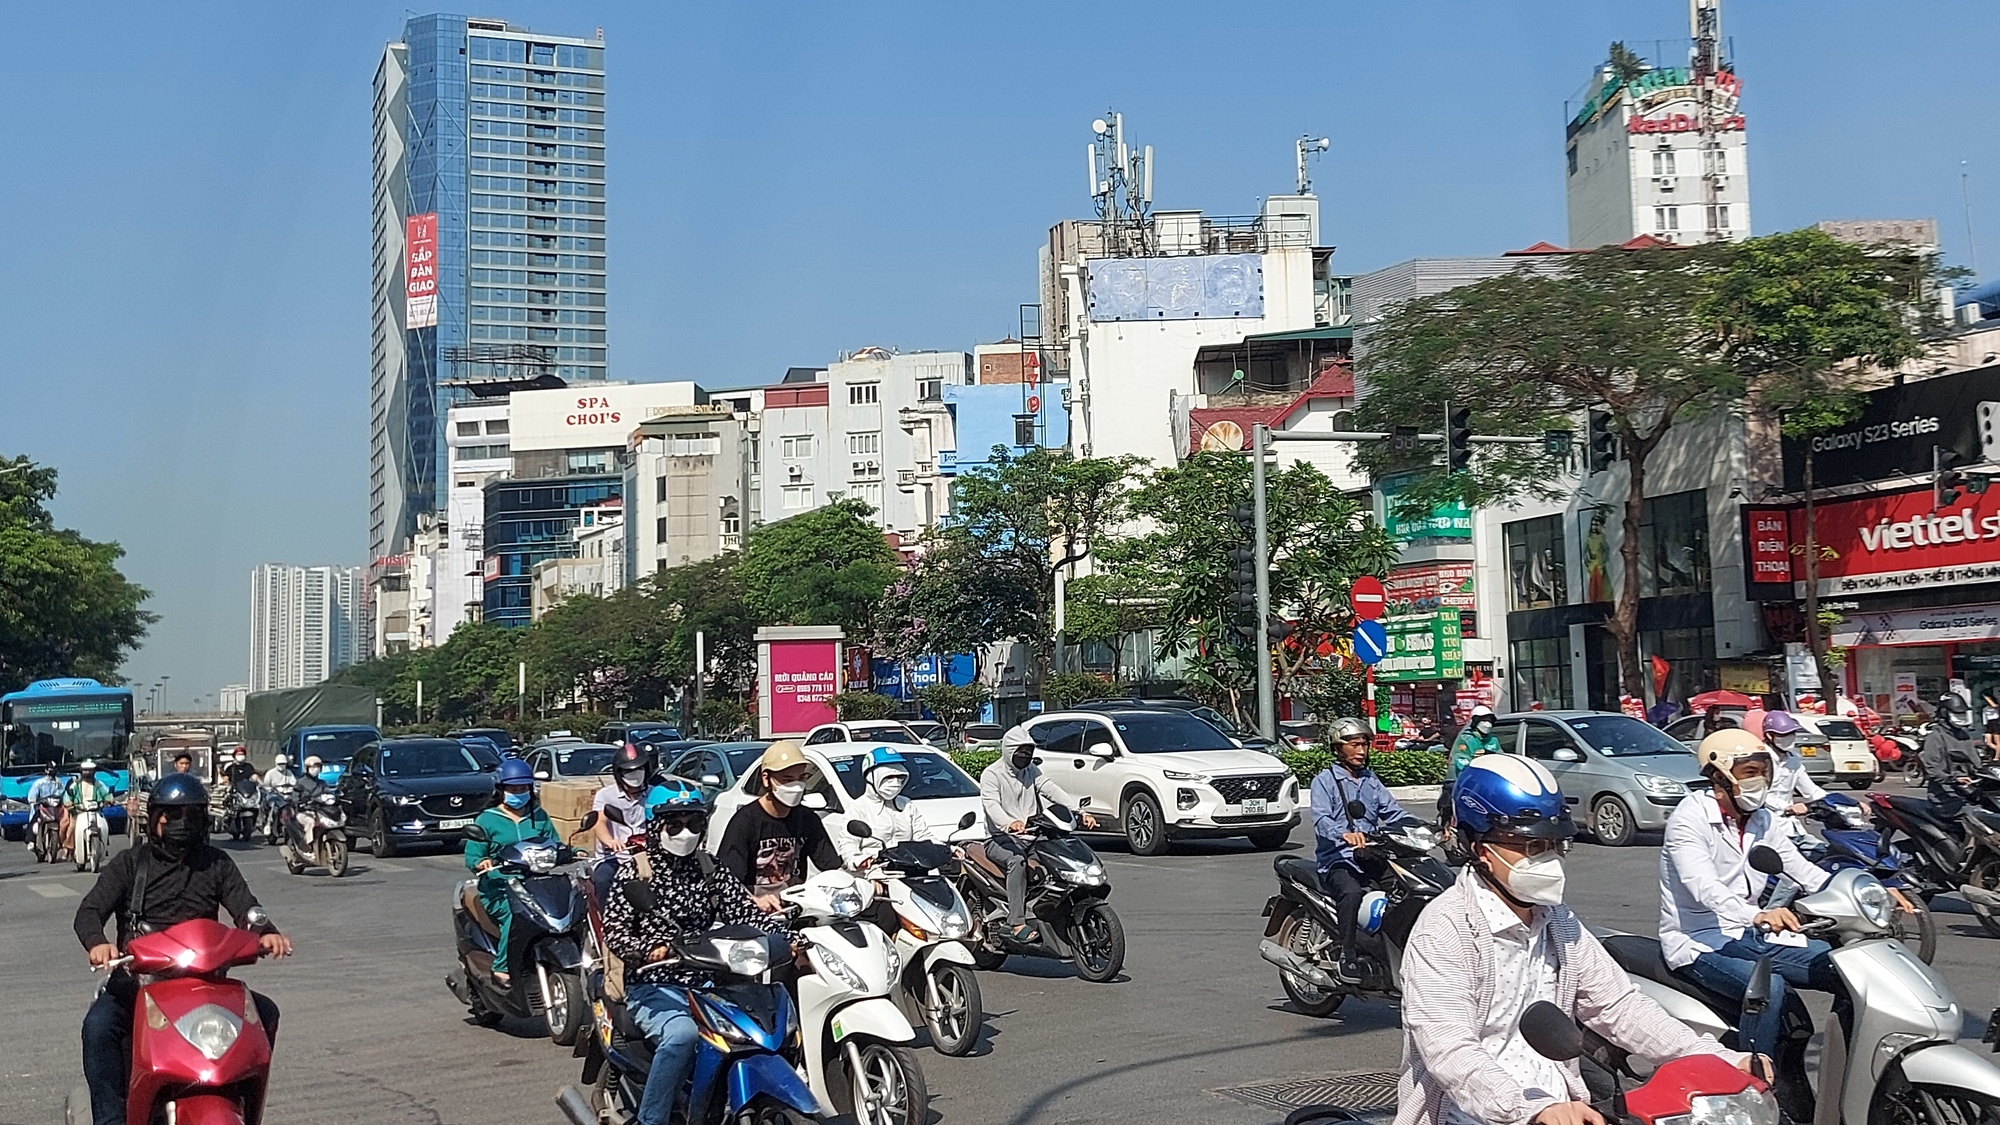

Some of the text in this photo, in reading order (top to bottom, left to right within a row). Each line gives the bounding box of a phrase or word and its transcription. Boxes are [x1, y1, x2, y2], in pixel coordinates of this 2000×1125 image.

[409, 280, 434, 293] GIAO
[577, 397, 610, 409] SPA
[566, 412, 621, 425] CHOI'S
[1811, 416, 1939, 452] Galaxy S23 Series
[1858, 508, 1980, 551] viettel
[1755, 561, 1790, 575] THOẠI
